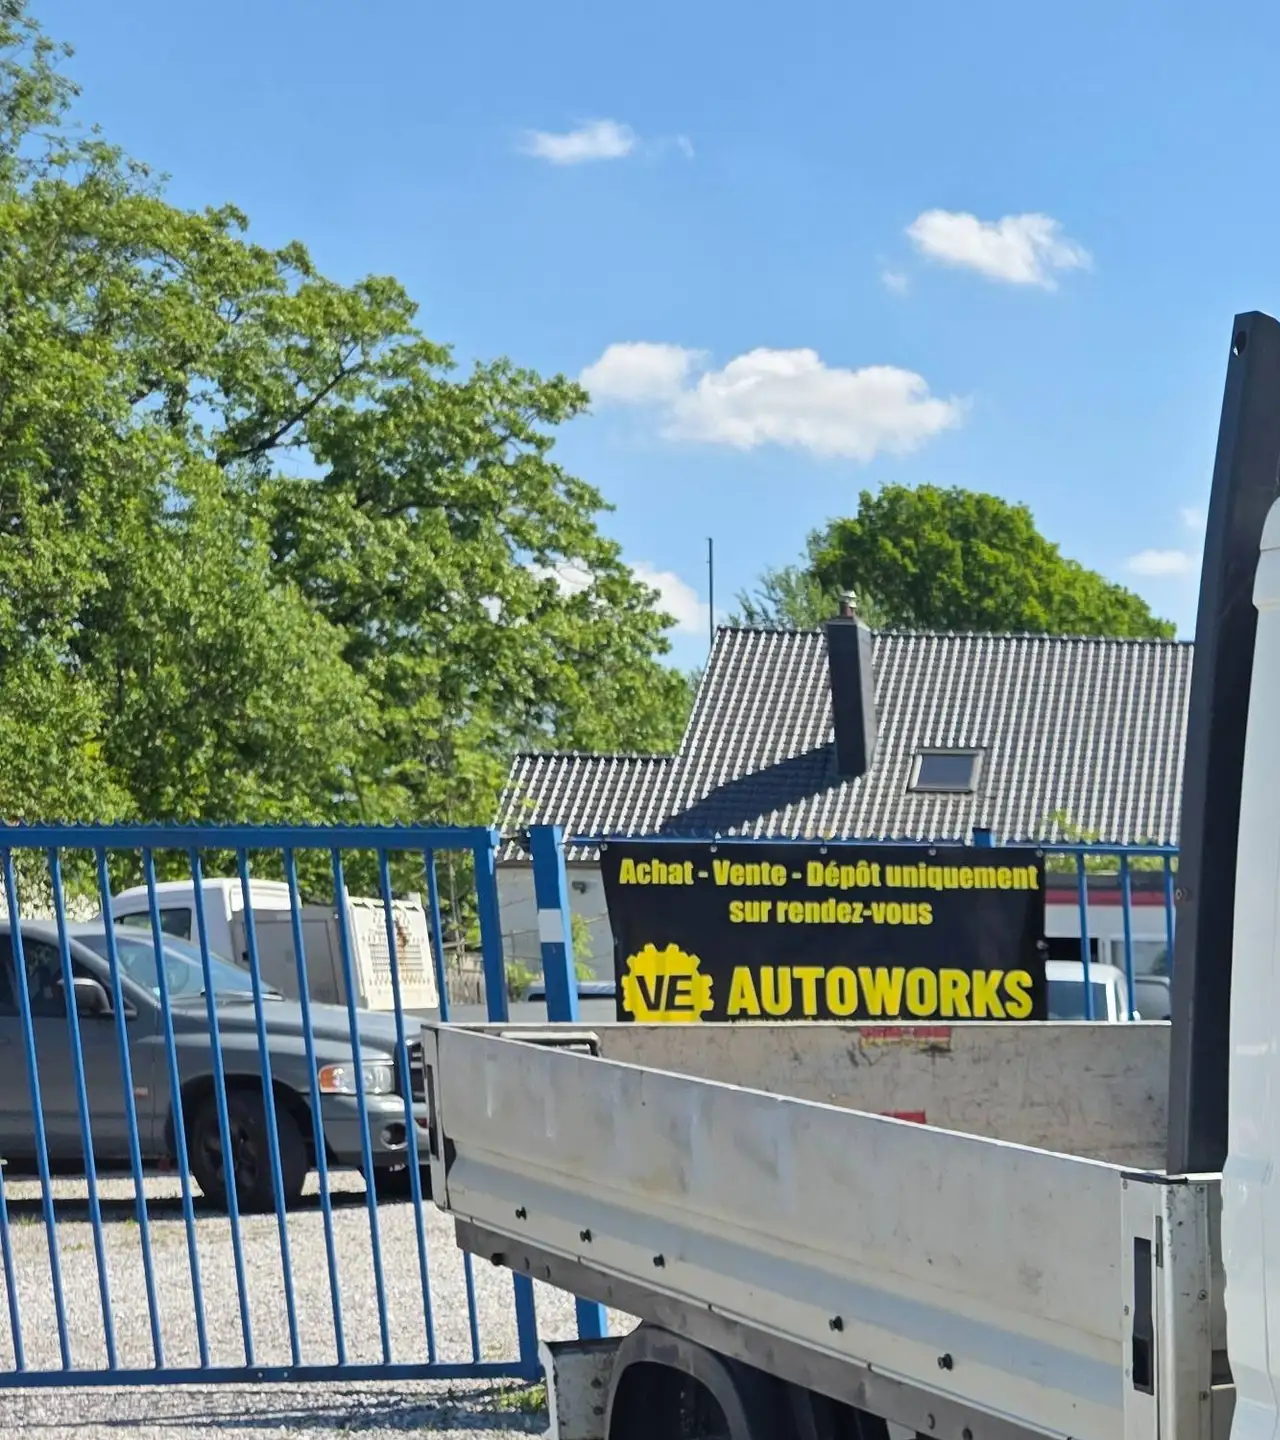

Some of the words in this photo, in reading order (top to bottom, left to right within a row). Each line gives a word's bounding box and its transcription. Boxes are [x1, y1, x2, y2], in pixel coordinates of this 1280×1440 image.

[619, 858, 694, 885] Achat
[712, 860, 787, 886] Vente
[806, 859, 881, 890] Dépôt
[885, 865, 1038, 890] uniquement
[729, 900, 771, 923] sur
[776, 898, 932, 925] rendez-vous
[635, 974, 696, 1012] VE
[726, 965, 1034, 1019] AUTOWORKS
